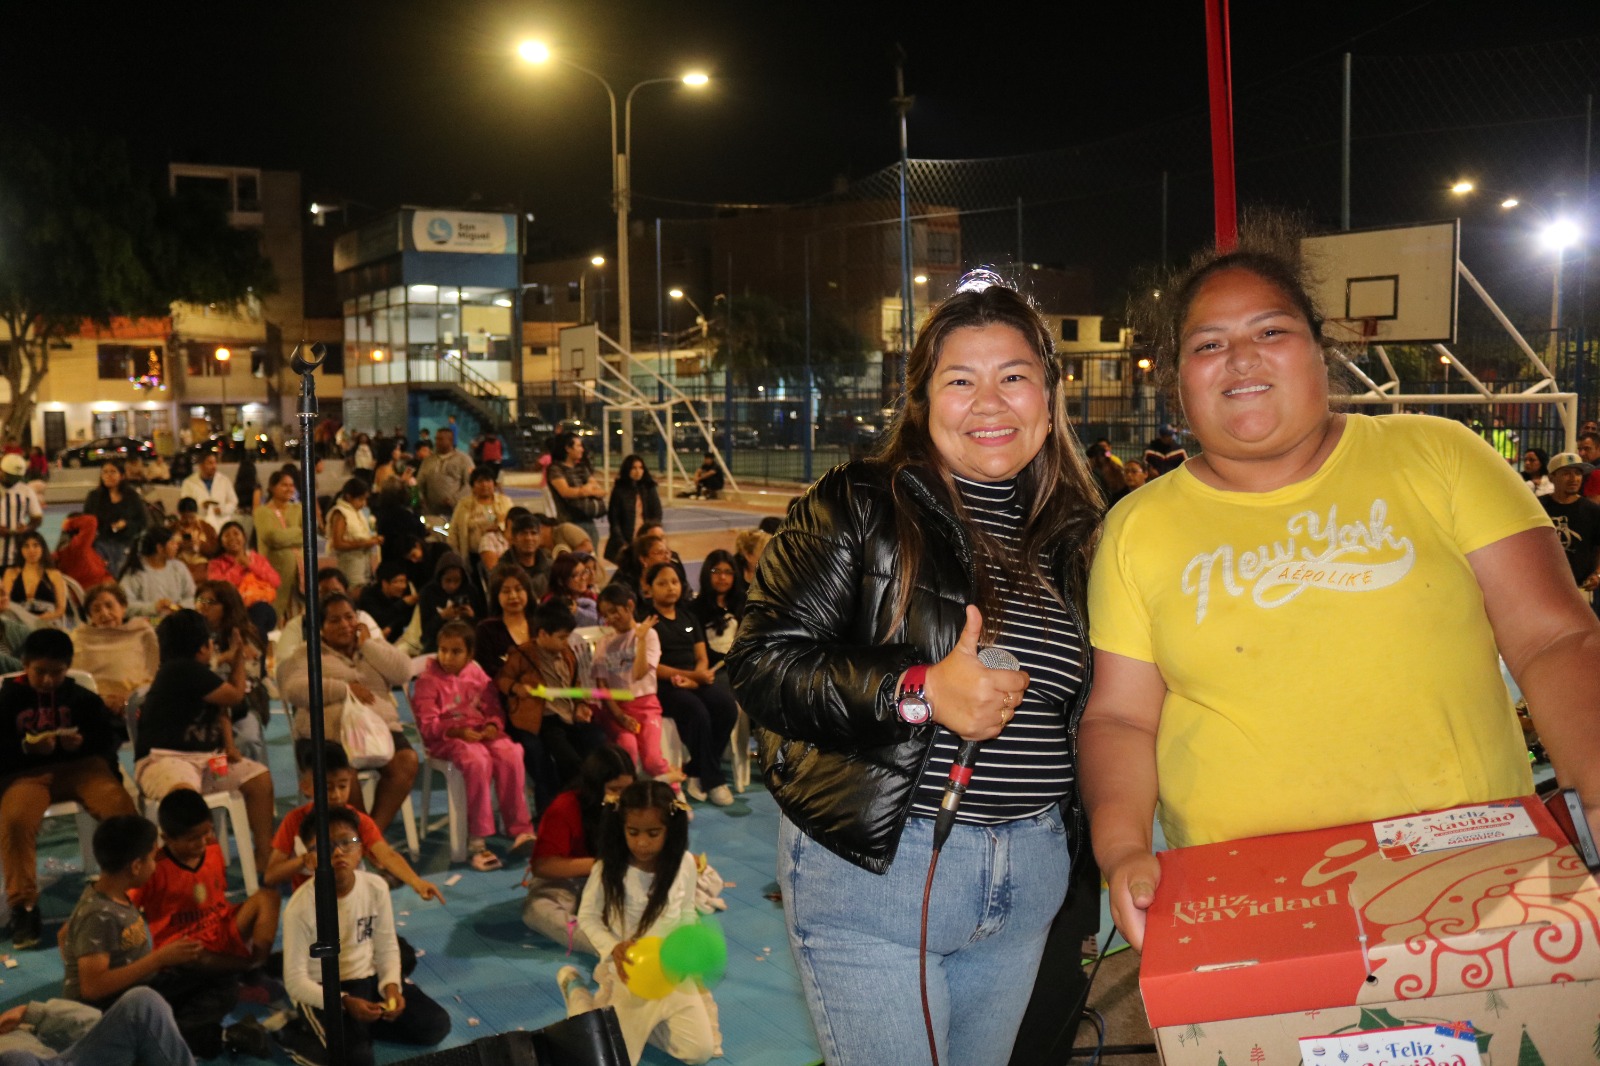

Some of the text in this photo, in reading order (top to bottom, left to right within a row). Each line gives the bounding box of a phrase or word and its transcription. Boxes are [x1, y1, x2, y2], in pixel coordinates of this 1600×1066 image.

[458, 222, 476, 231] San
[457, 232, 490, 241] Miguel
[1182, 499, 1409, 624] New York
[1424, 812, 1515, 833] Navidad
[1170, 889, 1340, 928] Navidad
[1174, 894, 1249, 913] Feliz
[1385, 1041, 1434, 1058] Feliz
